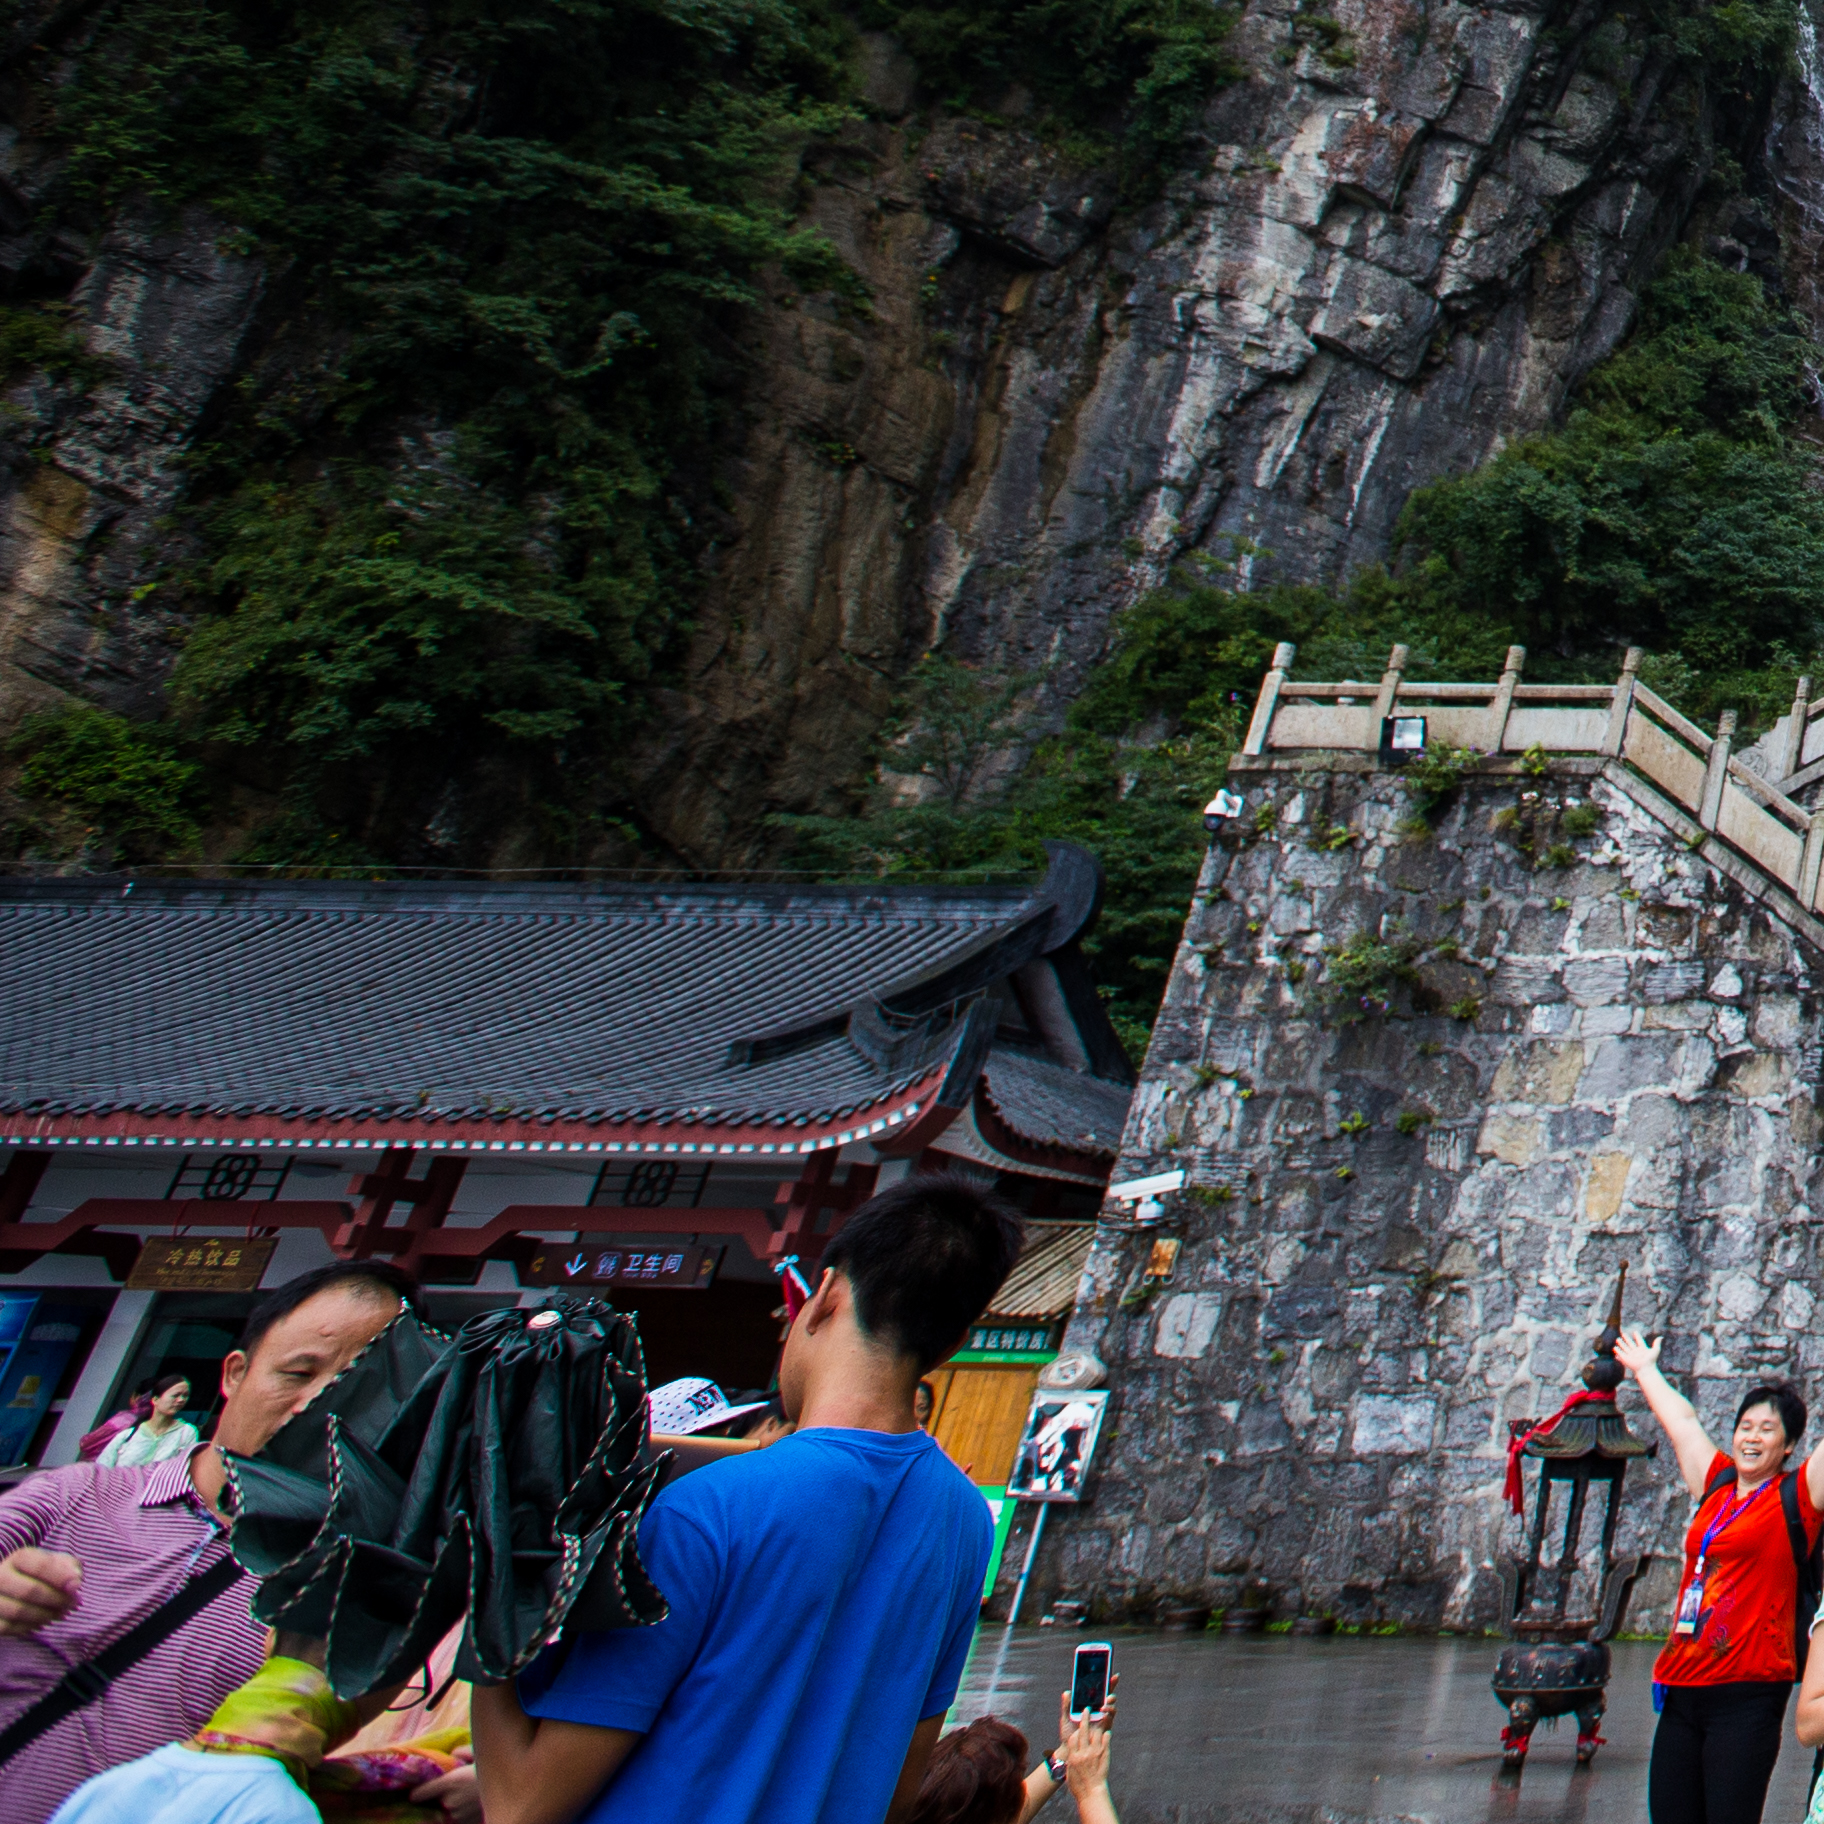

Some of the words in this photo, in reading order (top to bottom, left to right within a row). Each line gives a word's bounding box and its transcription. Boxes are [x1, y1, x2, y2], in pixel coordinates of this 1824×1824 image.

[164, 1248, 243, 1267] 冷热饮品
[622, 1252, 685, 1274] 卫生间
